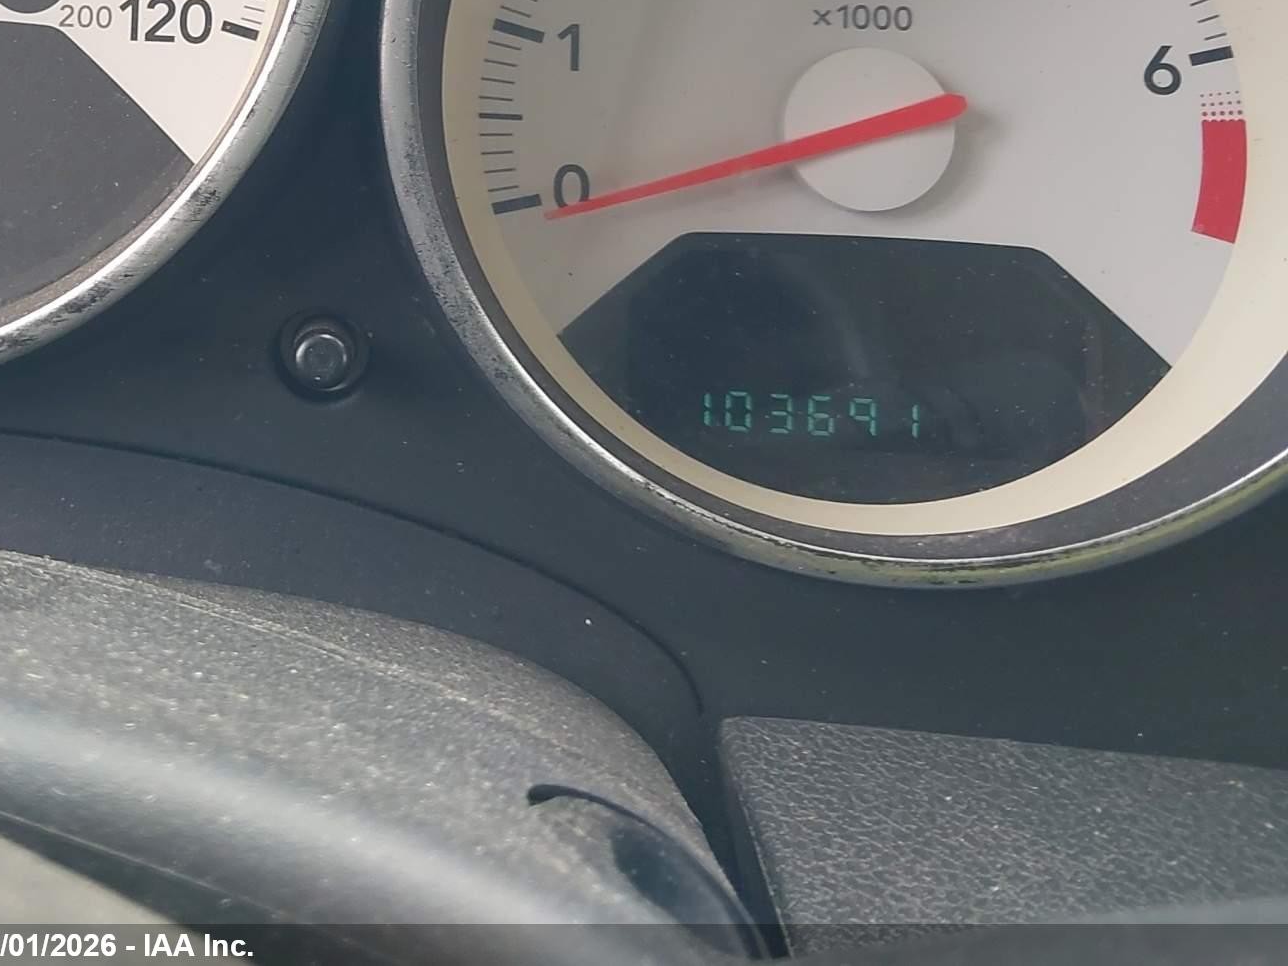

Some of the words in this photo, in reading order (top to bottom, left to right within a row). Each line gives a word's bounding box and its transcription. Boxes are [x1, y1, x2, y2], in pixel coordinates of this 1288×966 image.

[58, 4, 112, 29] 200
[558, 24, 579, 71] 1
[1144, 46, 1181, 95] 6
[553, 163, 591, 210] 0
[702, 391, 920, 438] 103691
